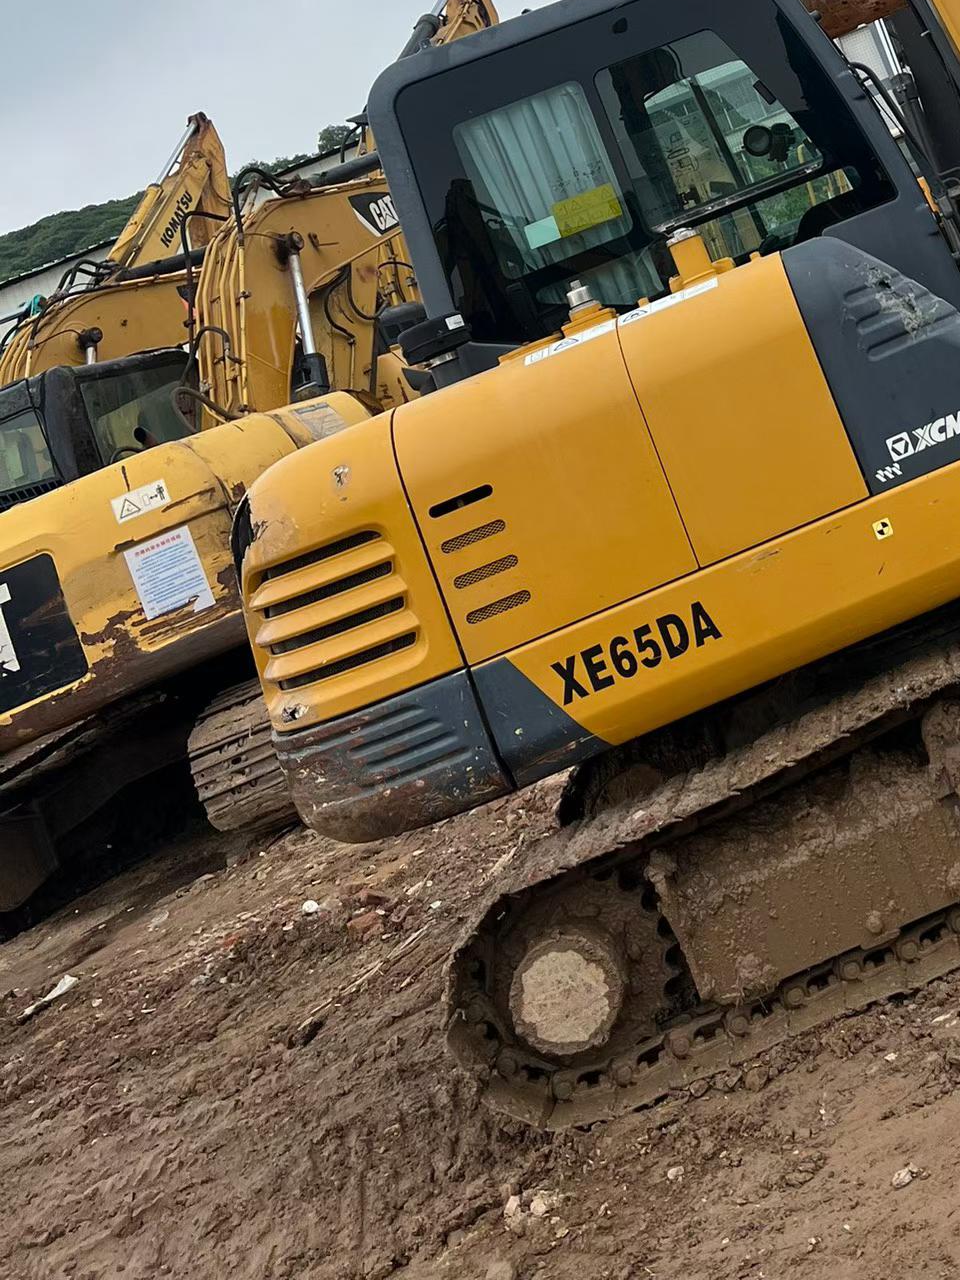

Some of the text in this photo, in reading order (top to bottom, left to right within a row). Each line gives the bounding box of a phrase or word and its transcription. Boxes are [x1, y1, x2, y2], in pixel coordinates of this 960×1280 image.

[160, 190, 193, 248] KOMATSU
[369, 194, 400, 231] CAT
[550, 601, 723, 706] XE65DA
